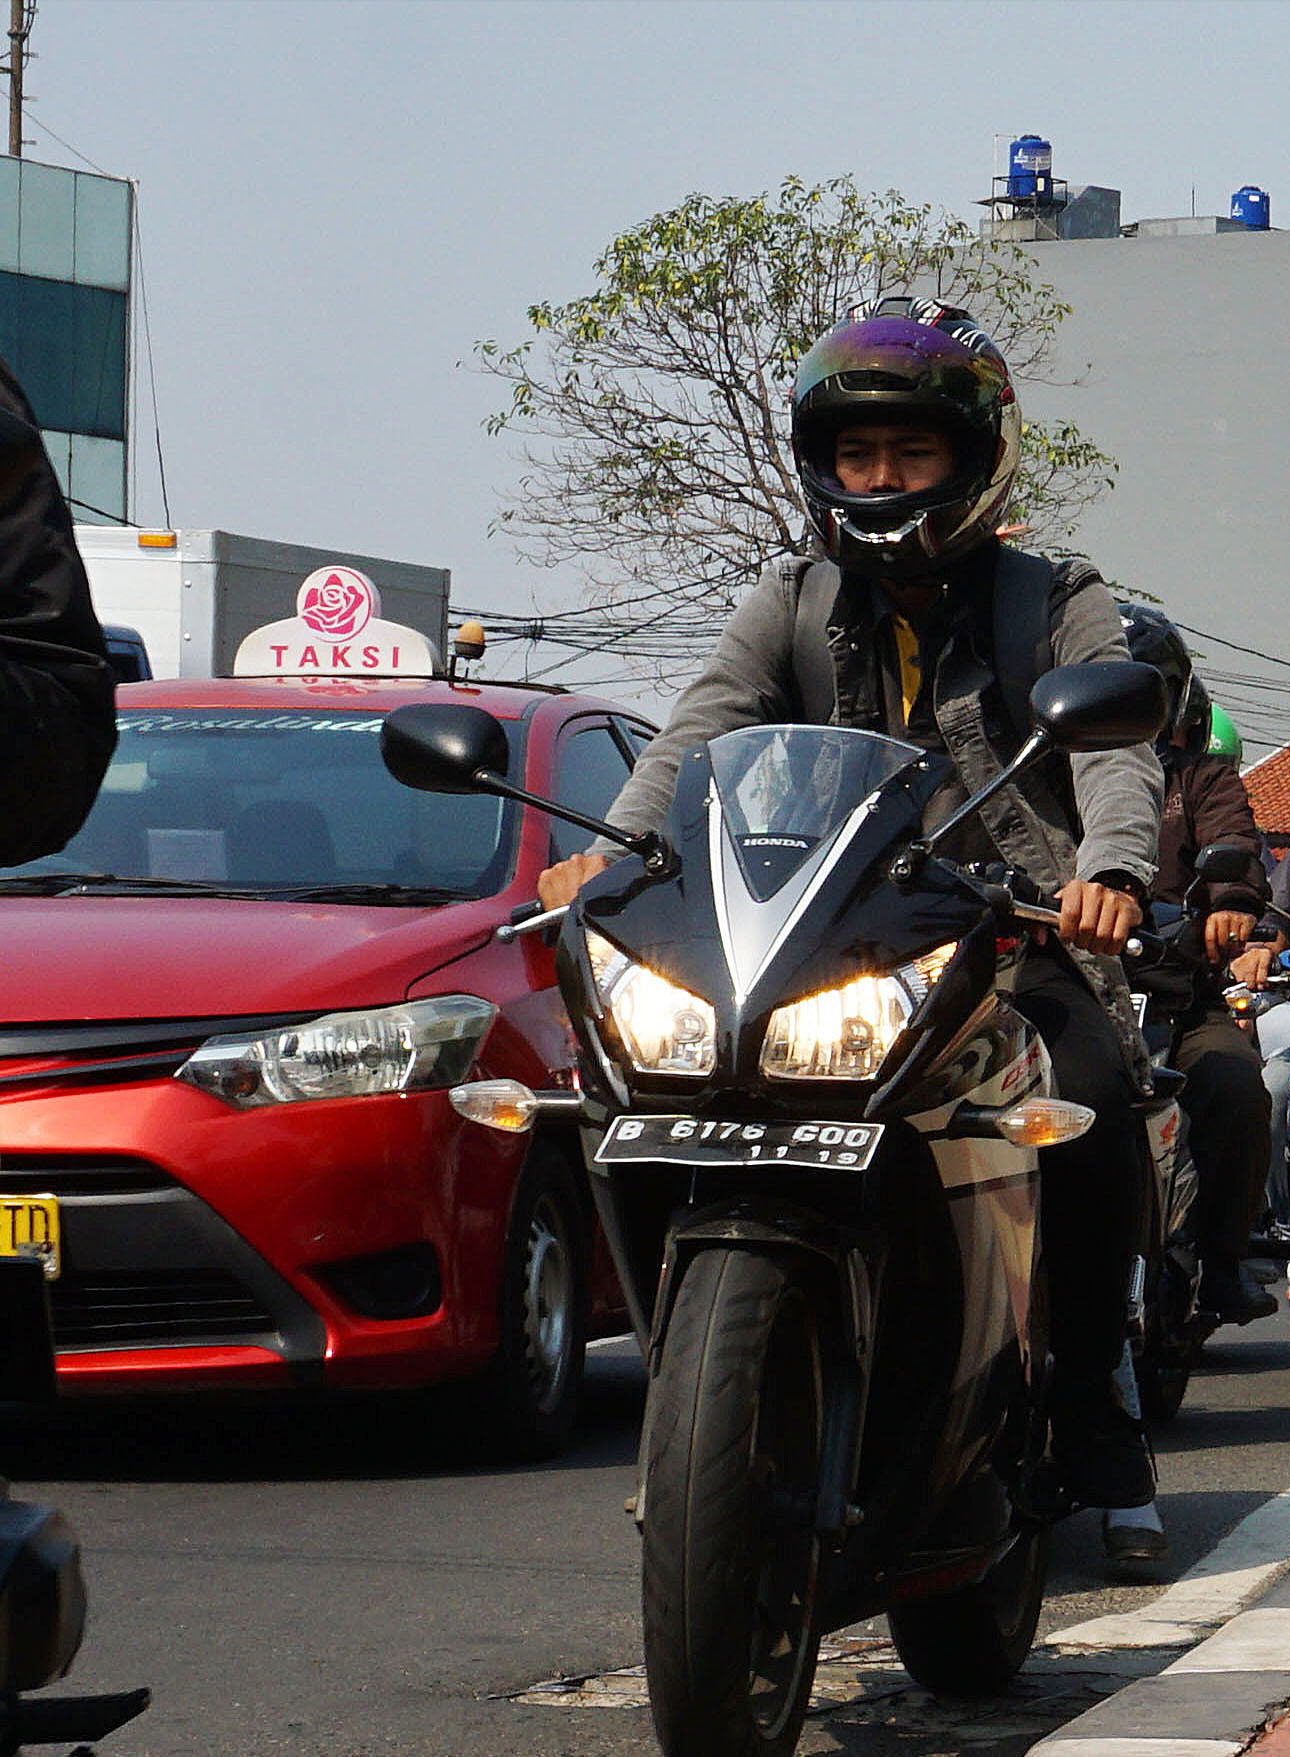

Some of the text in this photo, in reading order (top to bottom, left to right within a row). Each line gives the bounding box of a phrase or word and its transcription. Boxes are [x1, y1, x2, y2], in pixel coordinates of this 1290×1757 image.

[269, 645, 400, 669] TAKSI
[743, 838, 808, 849] HONDA
[616, 1121, 645, 1141] B
